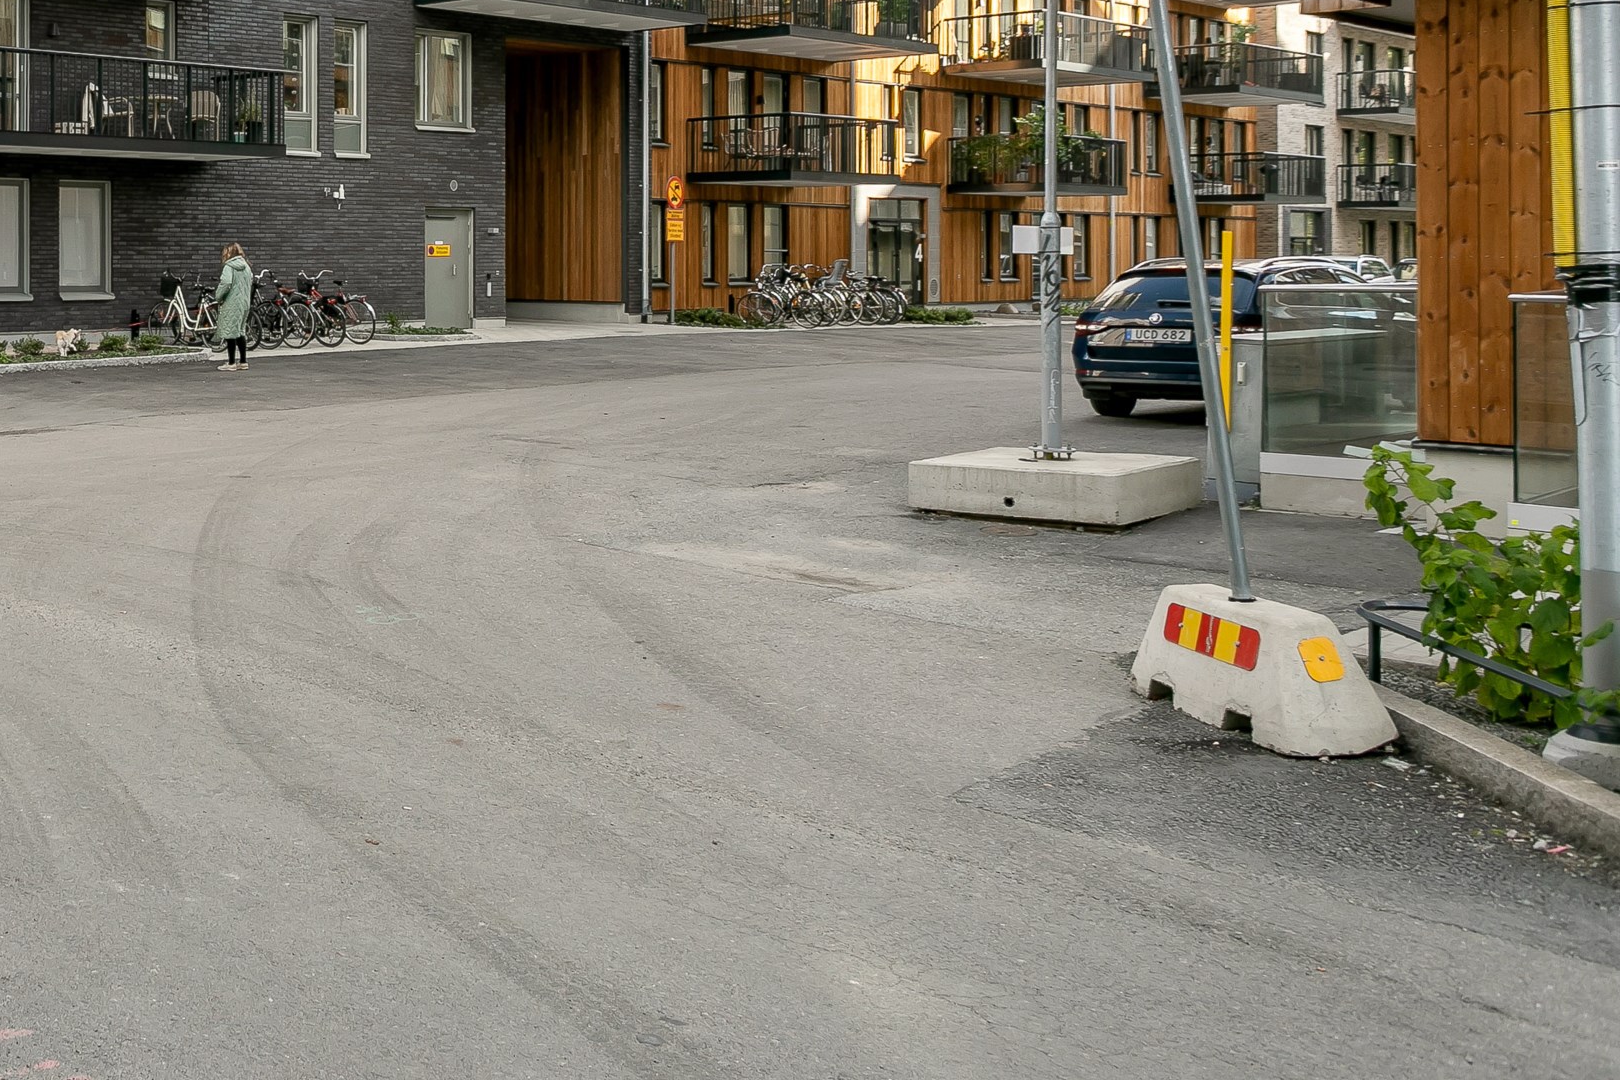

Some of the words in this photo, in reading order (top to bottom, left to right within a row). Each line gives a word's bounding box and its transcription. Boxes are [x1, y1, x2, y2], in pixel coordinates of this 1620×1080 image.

[915, 243, 923, 262] 4
[1135, 329, 1158, 340] UCD
[1161, 329, 1186, 340] 682
